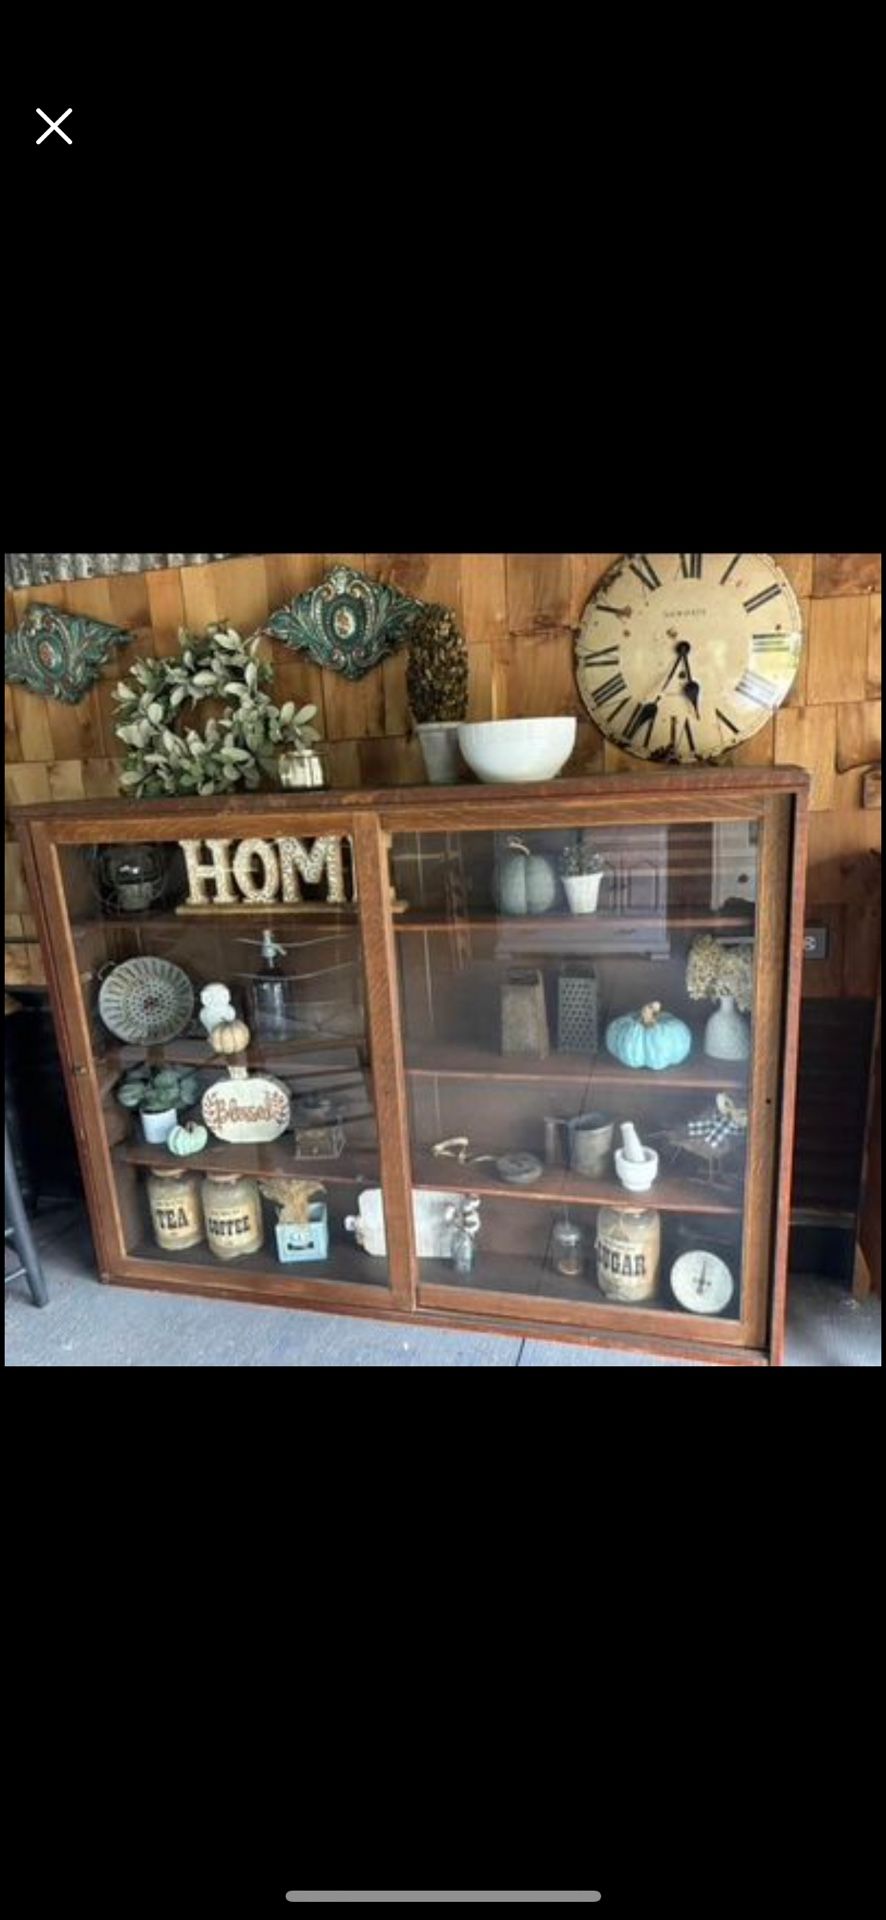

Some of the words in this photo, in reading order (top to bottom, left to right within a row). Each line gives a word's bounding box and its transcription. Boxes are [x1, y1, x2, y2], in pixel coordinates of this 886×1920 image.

[178, 835, 357, 903] HOM
[156, 1207, 188, 1230] TEA
[208, 1215, 251, 1236] COFFEE
